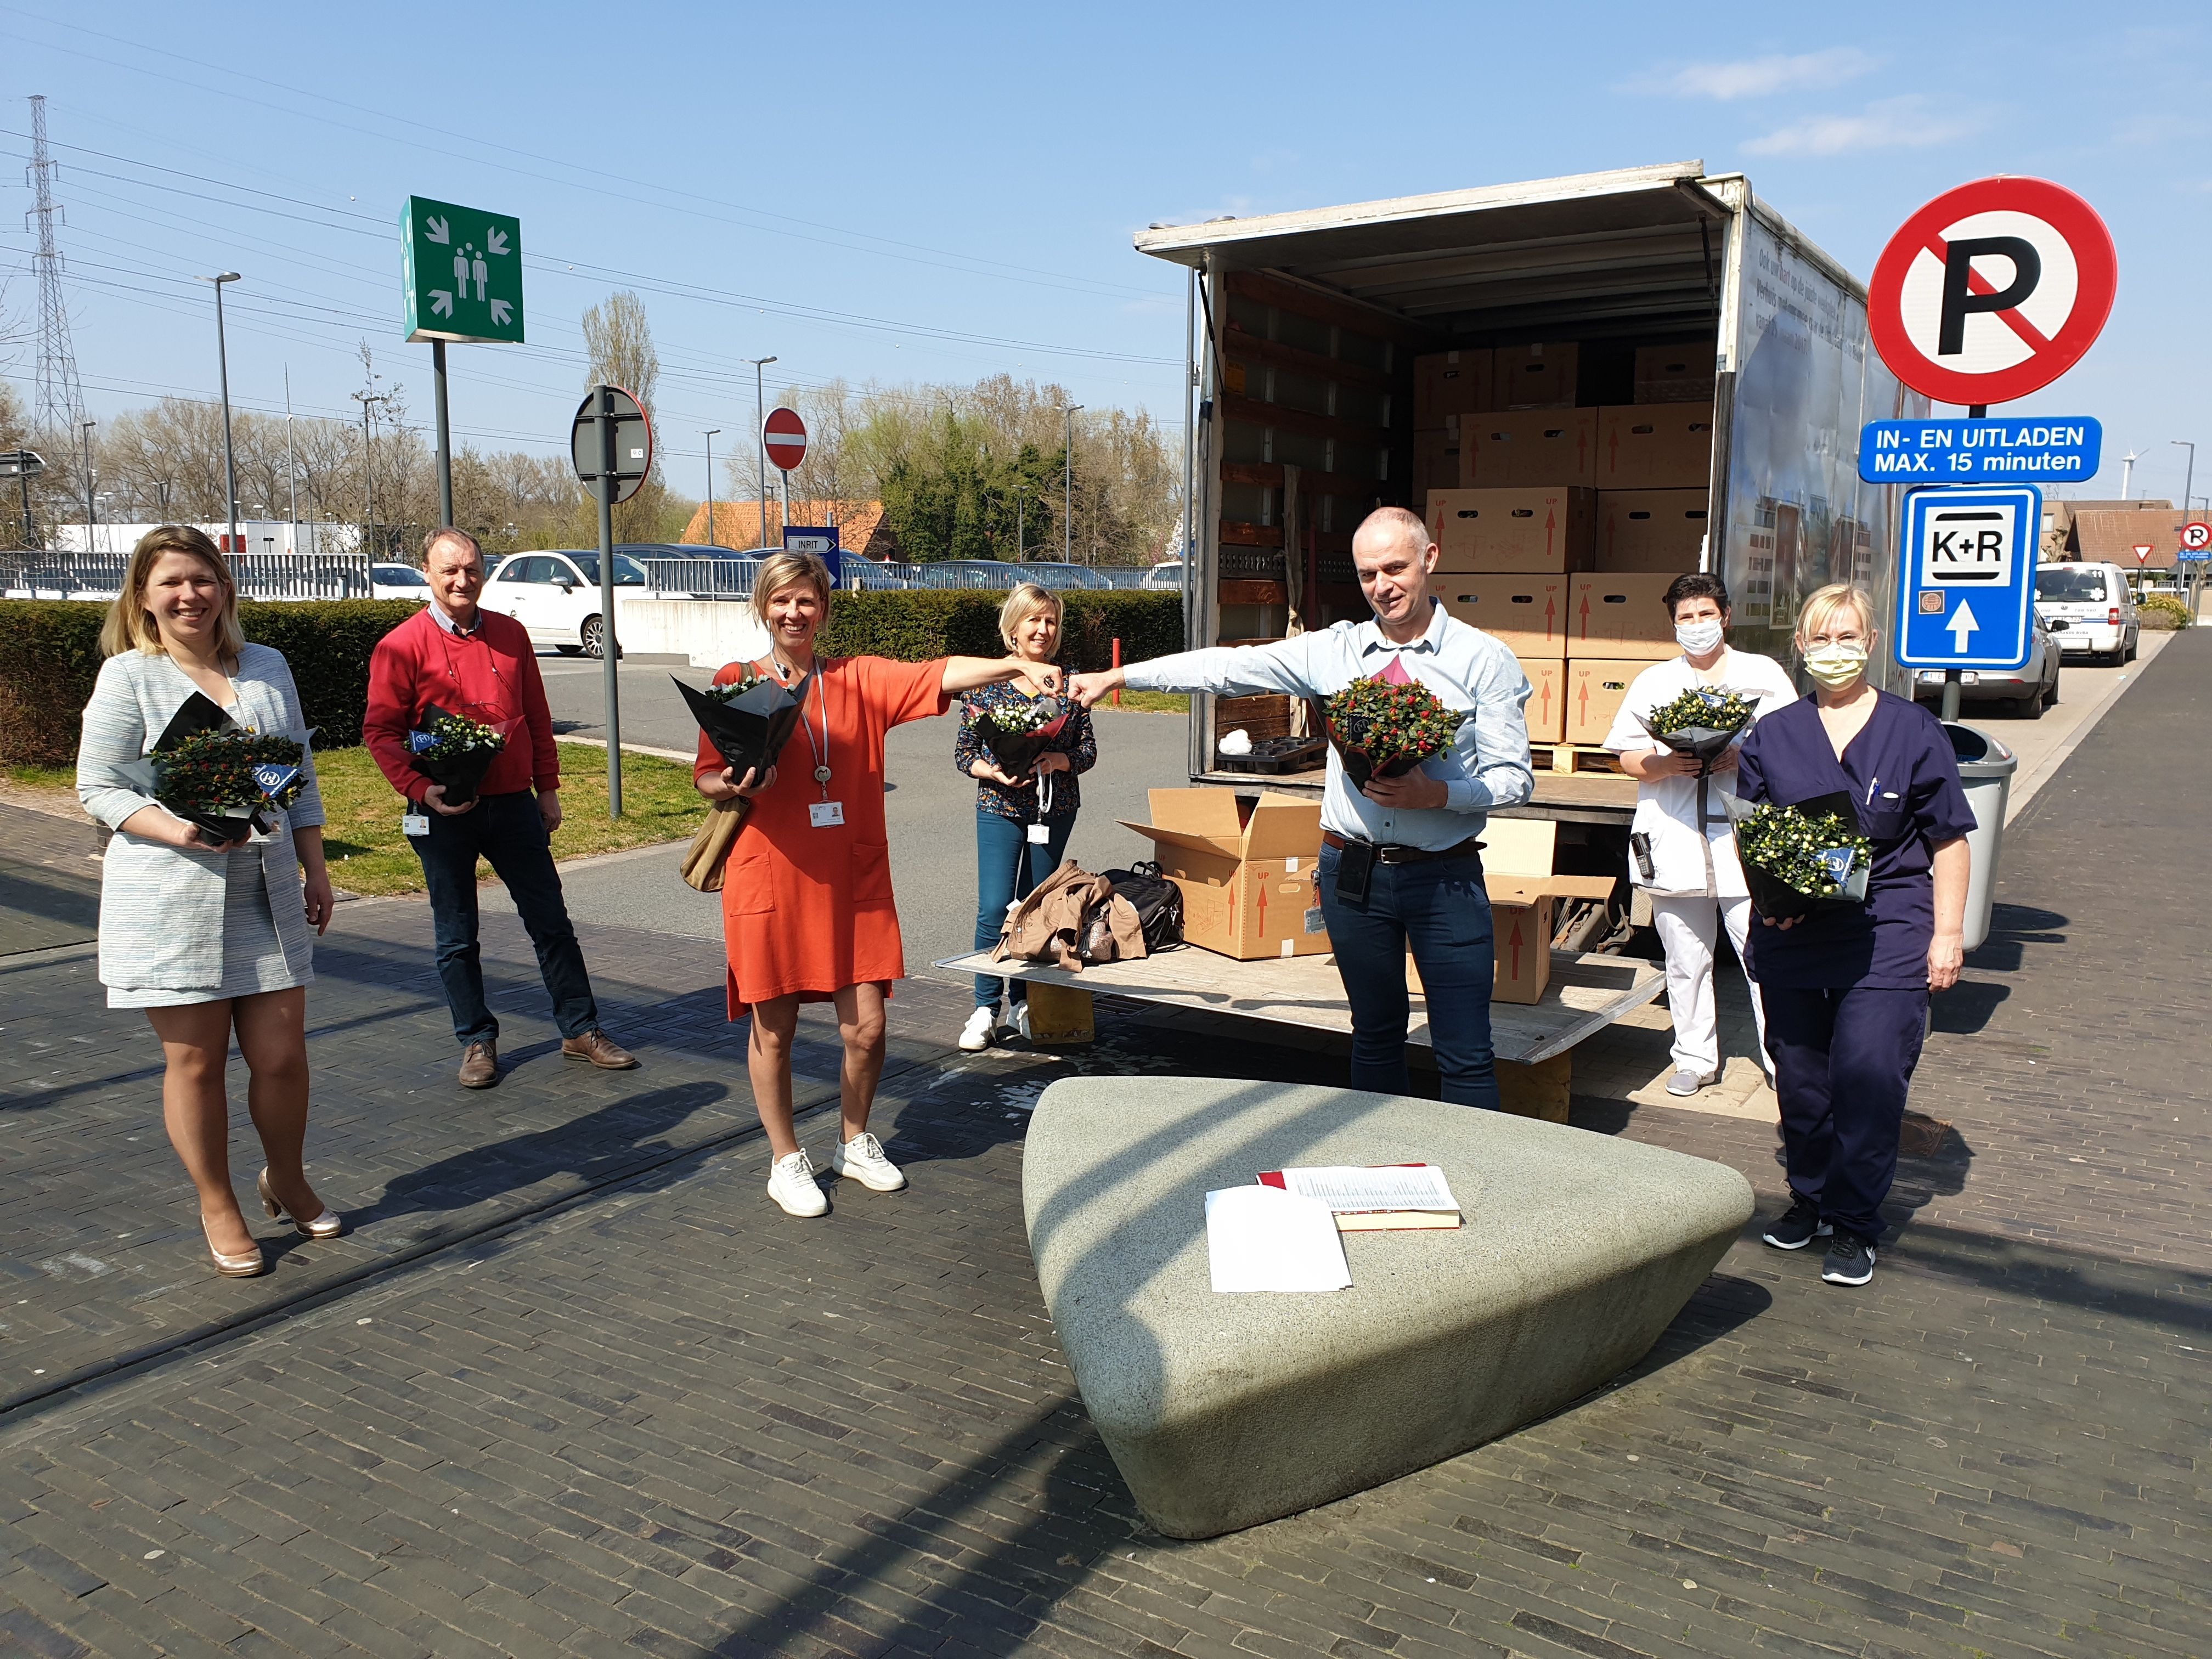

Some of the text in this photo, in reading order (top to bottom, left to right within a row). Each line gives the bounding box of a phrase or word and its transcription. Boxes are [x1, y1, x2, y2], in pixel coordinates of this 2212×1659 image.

[1938, 236, 2041, 355] P
[1877, 427, 2083, 448] IN- EN UITLADEN
[1876, 453, 2080, 471] MAX. 15 minuten
[798, 540, 818, 549] INRIT
[2190, 529, 2203, 543] P
[1933, 531, 2002, 561] K+R
[1228, 870, 1237, 878] UP
